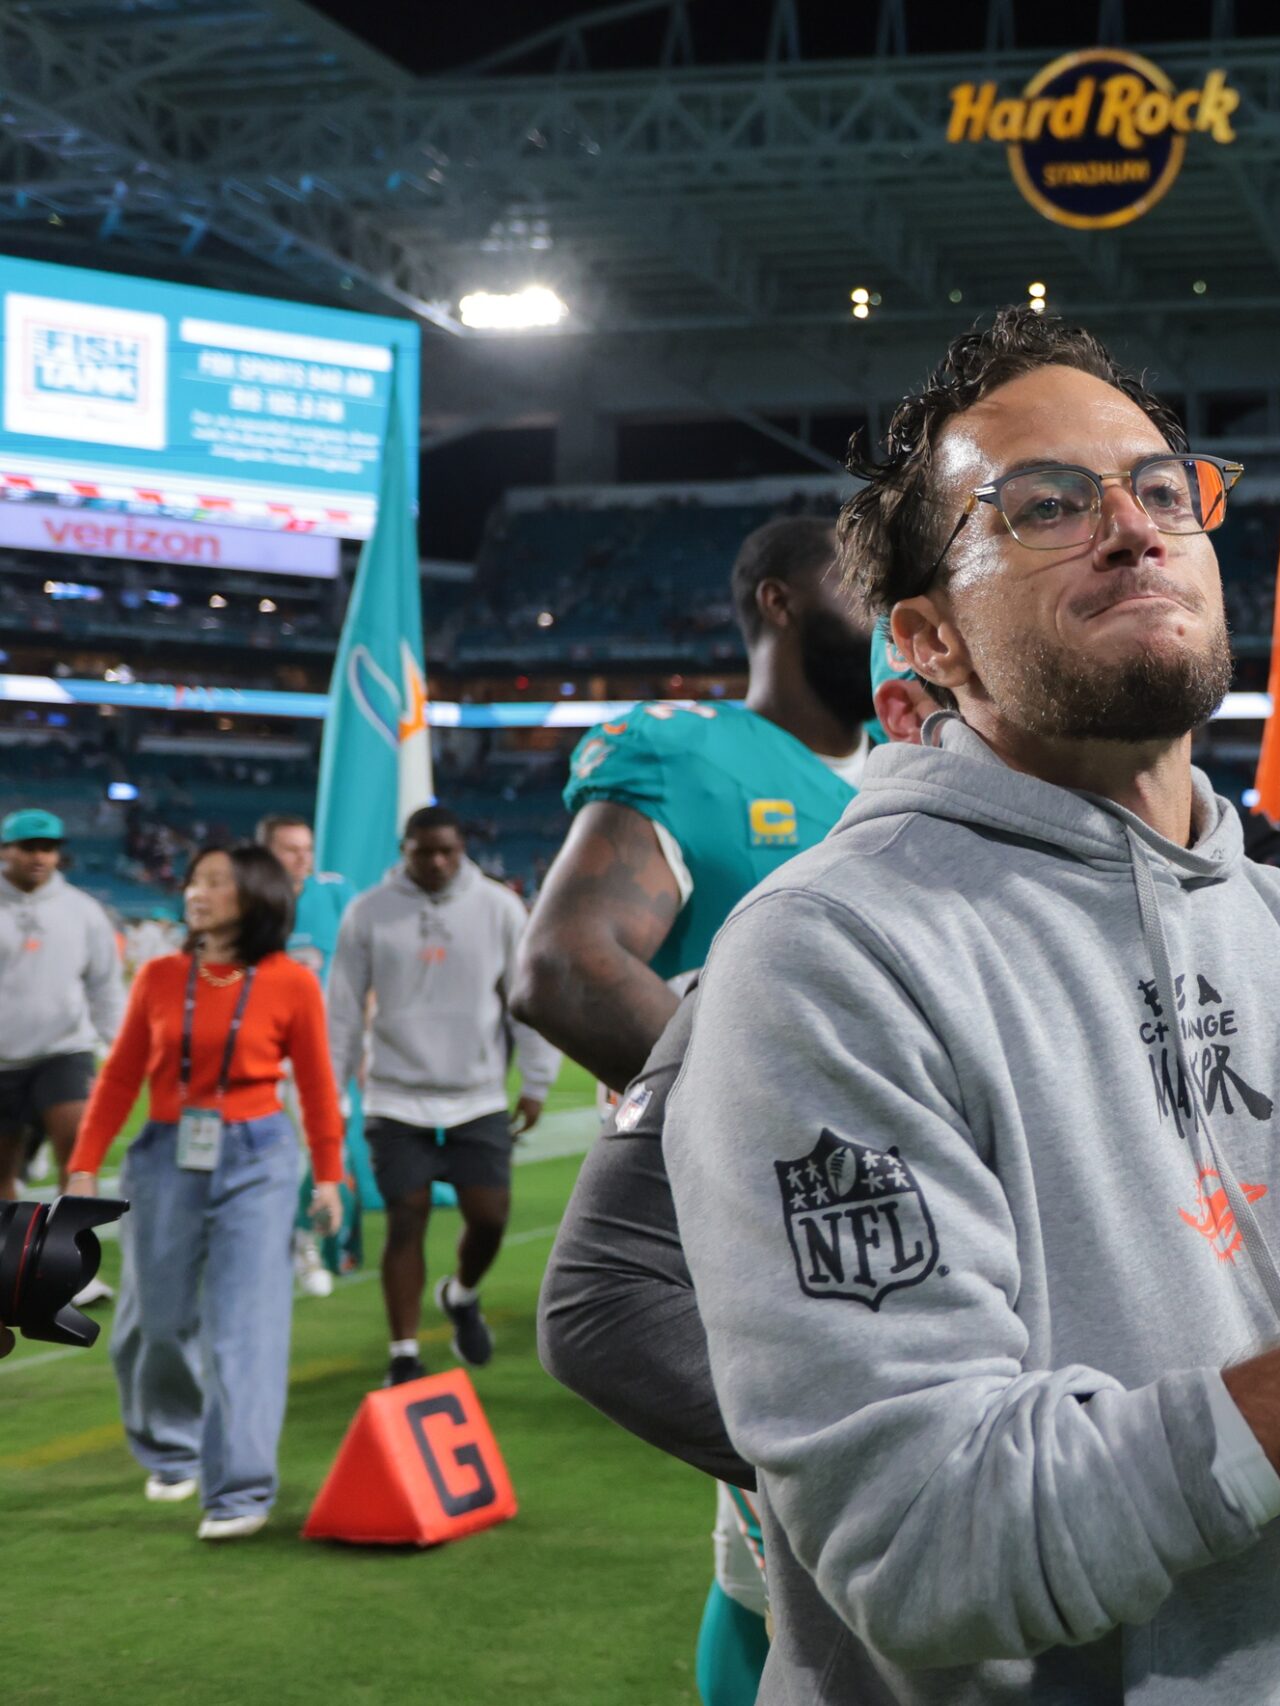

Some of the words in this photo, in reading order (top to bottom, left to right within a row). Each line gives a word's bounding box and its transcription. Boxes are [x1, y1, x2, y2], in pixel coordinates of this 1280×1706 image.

[947, 76, 1096, 143] Hard
[1096, 69, 1240, 149] Rock
[42, 514, 221, 561] verizon
[750, 799, 796, 836] C
[799, 1201, 924, 1288] NFL
[405, 1393, 496, 1517] G
